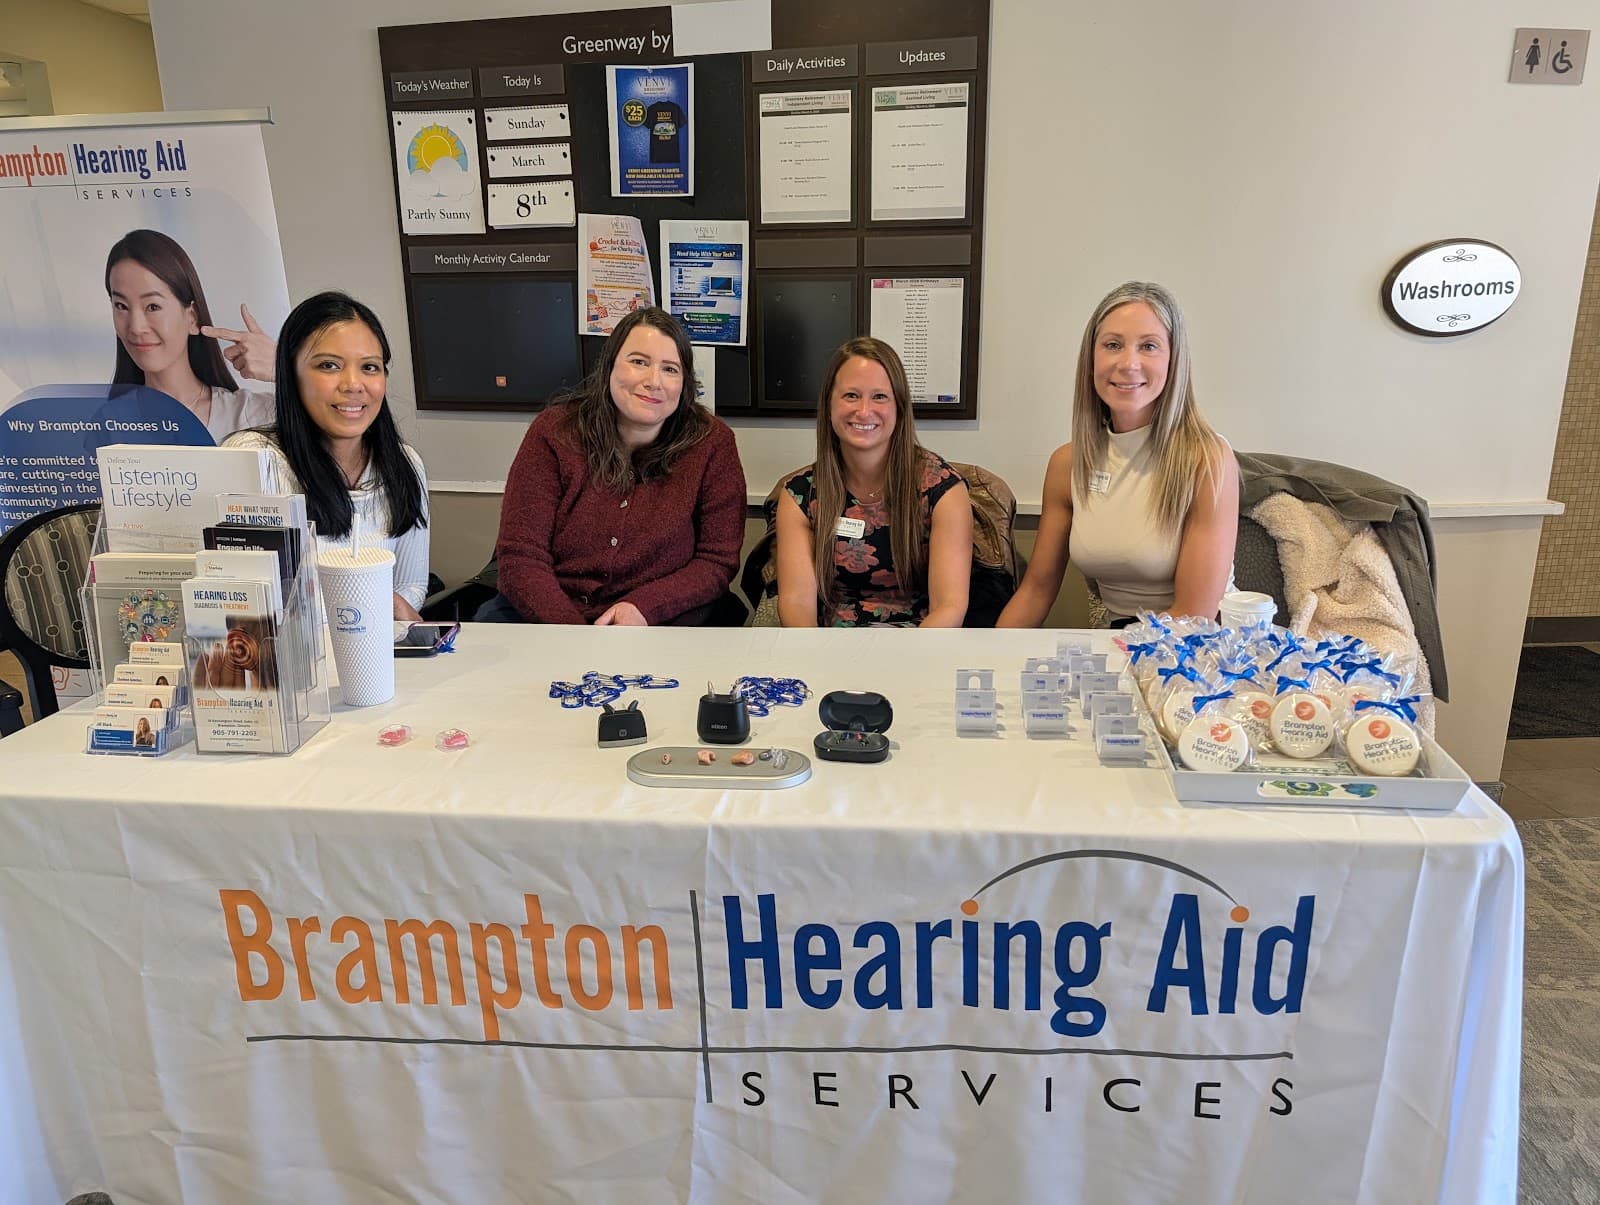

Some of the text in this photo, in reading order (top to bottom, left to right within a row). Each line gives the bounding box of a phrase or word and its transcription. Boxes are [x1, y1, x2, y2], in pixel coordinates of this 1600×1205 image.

[562, 30, 671, 54] Greenway by
[899, 50, 946, 65] Updates
[767, 56, 846, 73] Daily Activities
[396, 79, 470, 93] Today's Weather
[503, 75, 542, 89] Today Is
[625, 105, 643, 116] $25
[507, 117, 546, 130] Sunday
[73, 143, 151, 179] Hearing
[156, 139, 187, 172] Aid
[512, 155, 545, 167] March
[83, 187, 192, 200] SERVICES
[516, 190, 547, 218] 8th
[407, 208, 471, 222] Partly Sunny
[435, 252, 551, 267] Monthly Activity Calendar
[689, 250, 700, 258] Help
[1399, 278, 1515, 301] Washrooms
[8, 419, 179, 433] Why Brampton Chooses Us
[22, 455, 86, 466] committed
[22, 469, 100, 481] cutting-edge
[108, 465, 198, 491] Listening
[61, 482, 73, 493] in
[76, 482, 96, 493] the
[63, 498, 79, 506] we
[112, 486, 193, 512] Lifestyle
[227, 504, 279, 514] HEAR WHAT YOU'VE
[225, 514, 283, 526] BEEN MISSING!
[193, 590, 248, 602] HEARING LOSS
[196, 698, 263, 708] Brampton Hearing Aid
[1284, 720, 1326, 731] Brampton
[1280, 728, 1329, 739] Hearing Aid
[220, 888, 1316, 1042] Brampton Hearing Aid
[742, 1069, 1294, 1120] SERVICES
